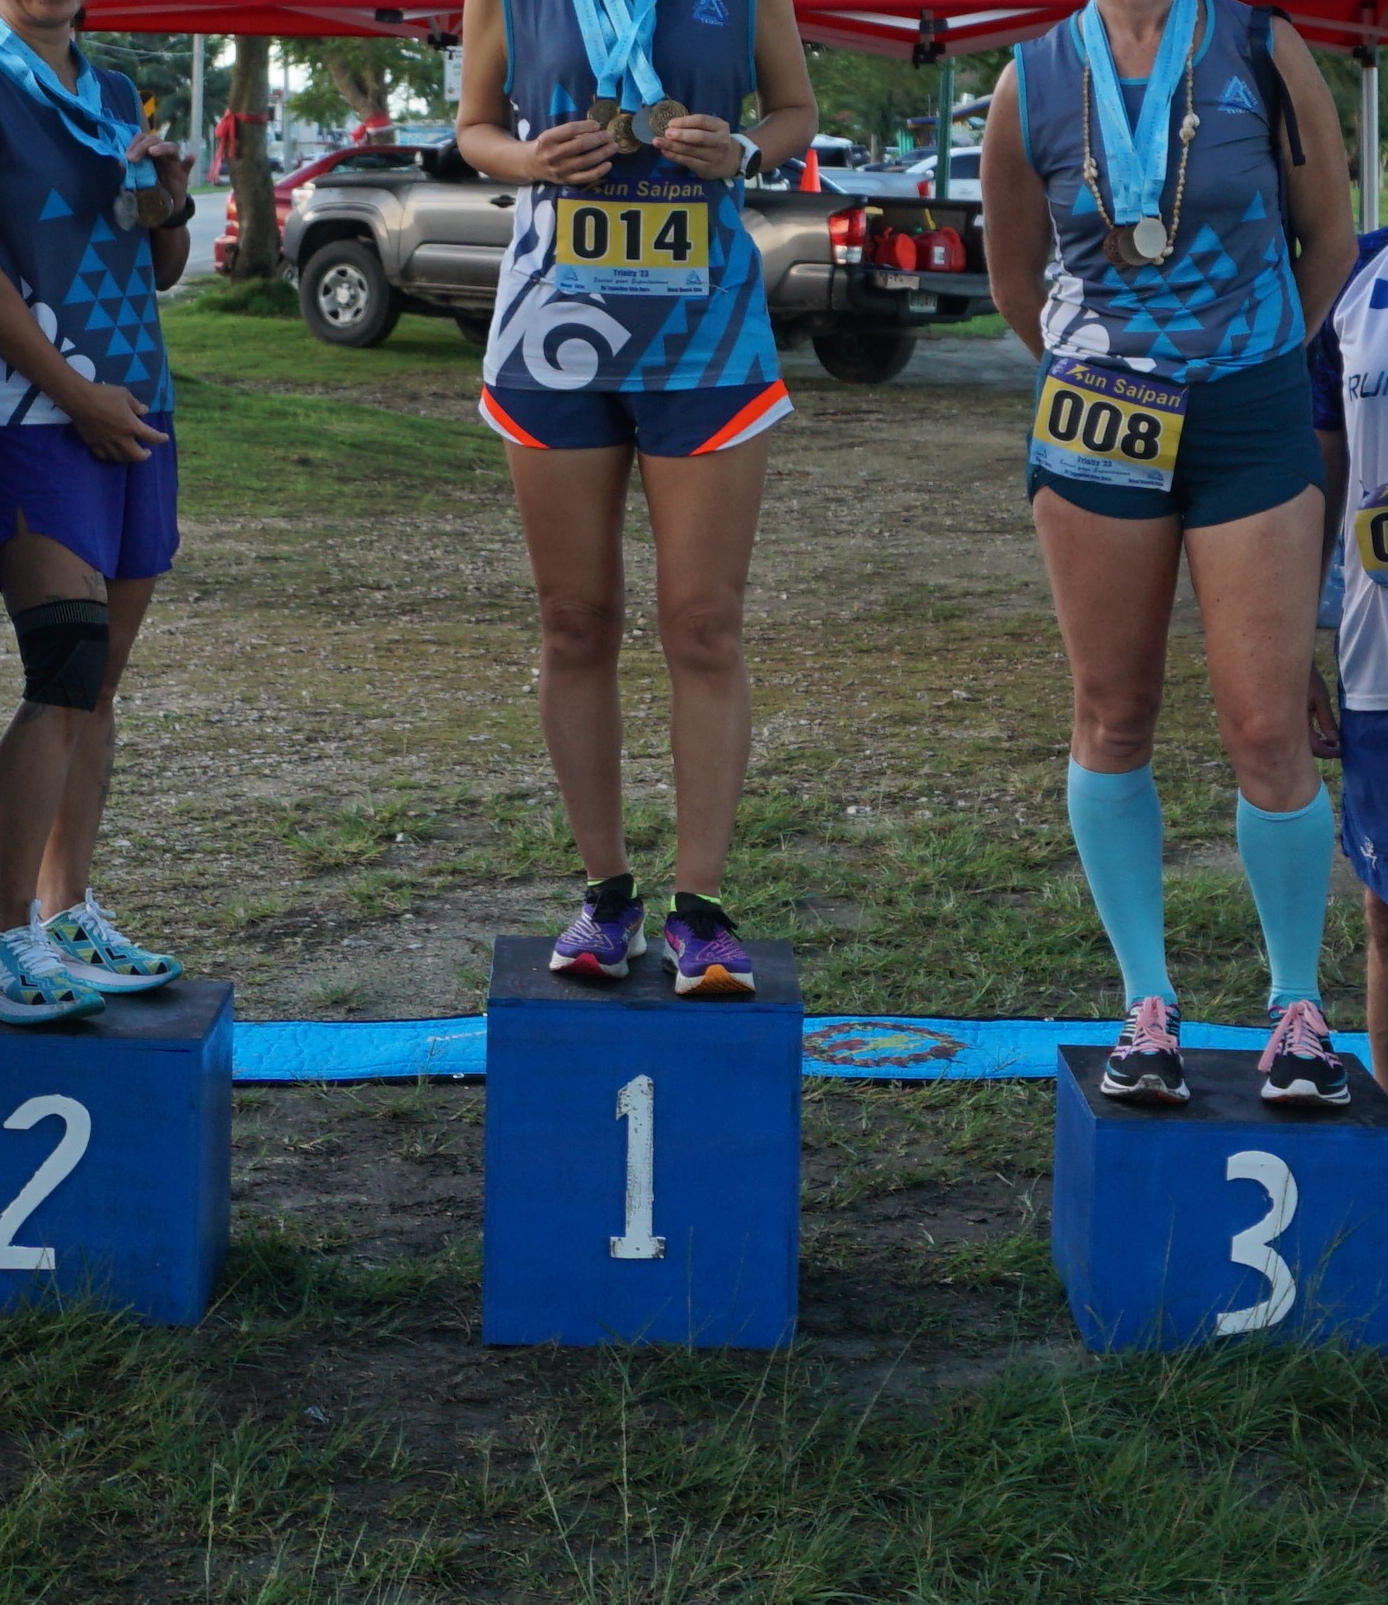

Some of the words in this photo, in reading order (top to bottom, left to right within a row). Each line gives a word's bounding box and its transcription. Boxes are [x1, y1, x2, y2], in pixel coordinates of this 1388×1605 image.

[637, 181, 704, 201] Saipan
[572, 206, 694, 263] 014
[1048, 389, 1163, 461] 008
[1113, 378, 1183, 408] Saipan
[610, 1074, 666, 1260] 1
[1216, 1149, 1299, 1337] 3
